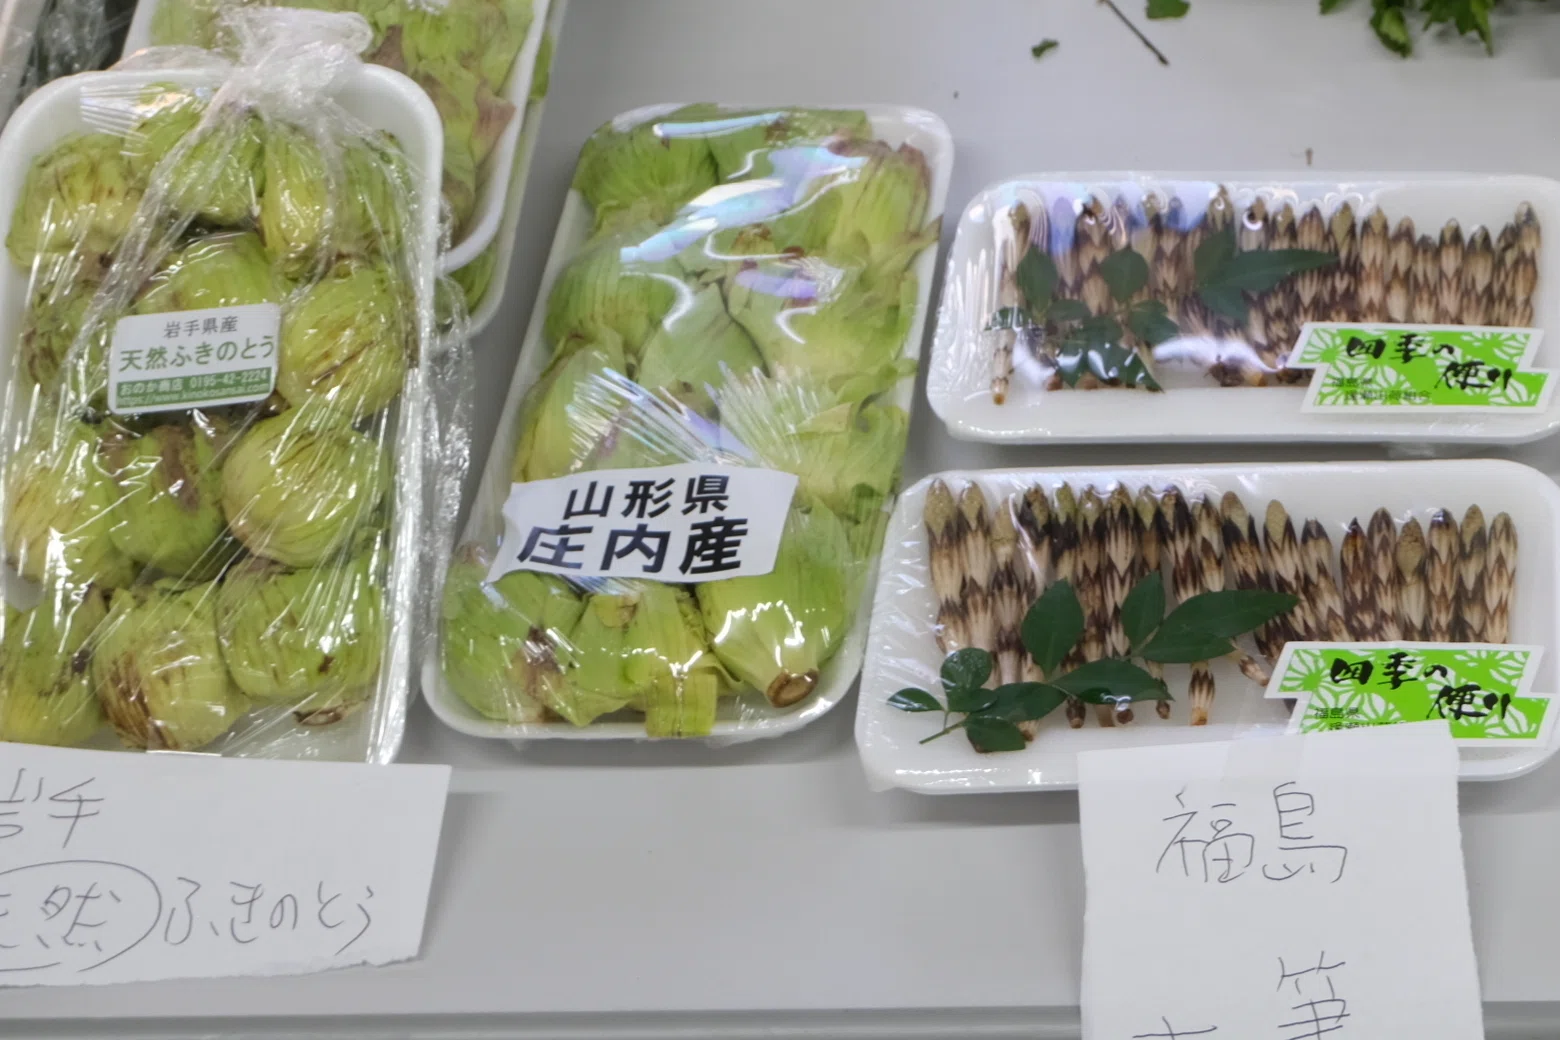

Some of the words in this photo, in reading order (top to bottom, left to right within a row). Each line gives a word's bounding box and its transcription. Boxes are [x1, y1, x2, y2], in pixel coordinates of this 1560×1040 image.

[163, 316, 239, 339] 岩手県産
[118, 335, 275, 373] 天然ふきのとう
[1346, 332, 1455, 365] 四季の
[189, 370, 268, 388] 0195-42-2224
[562, 474, 731, 520] 山形県
[516, 516, 748, 575] 庄内産
[1330, 652, 1448, 690] 四季の
[1314, 706, 1361, 720] 福島県
[1155, 781, 1348, 884] 福島
